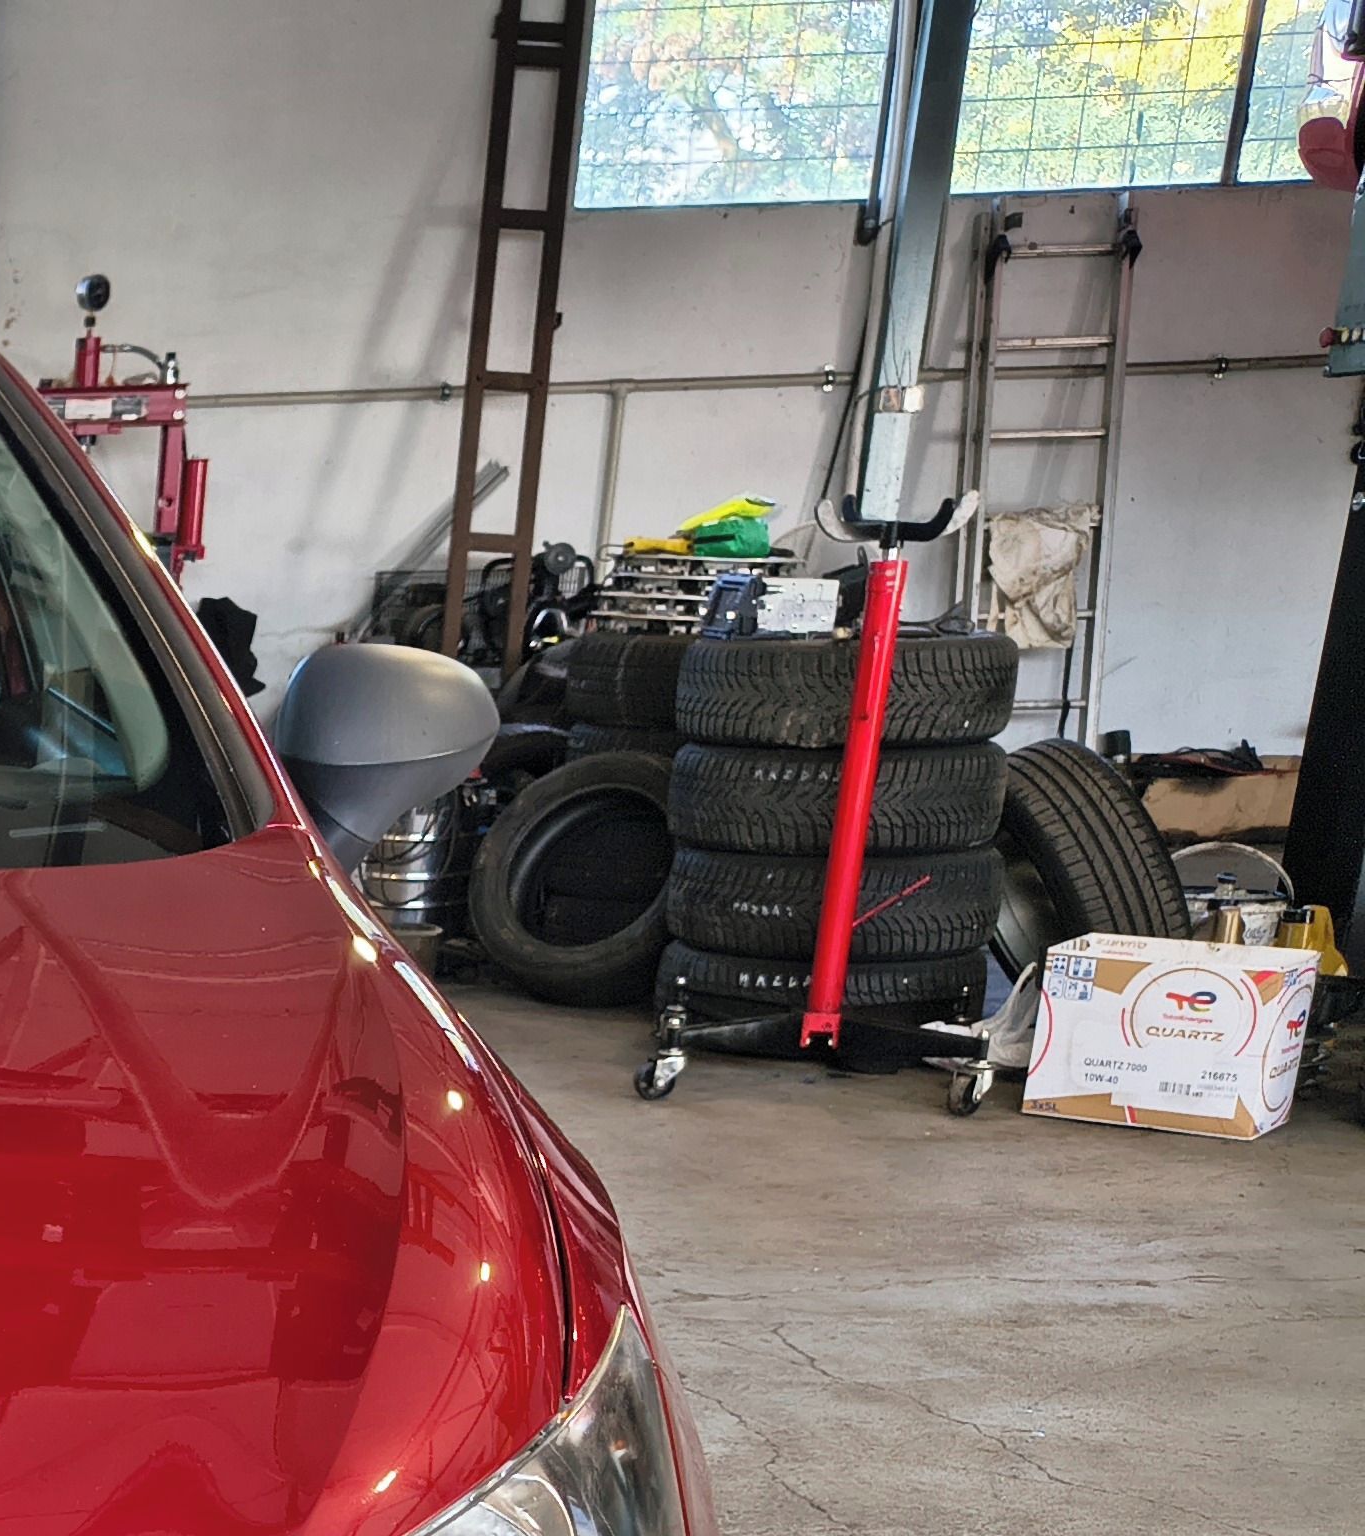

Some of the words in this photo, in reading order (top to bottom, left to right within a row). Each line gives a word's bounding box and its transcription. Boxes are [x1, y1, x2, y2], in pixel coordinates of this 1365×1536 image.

[1145, 1026, 1225, 1042] QUARTZ
[1083, 1057, 1124, 1070] QUARTZ
[1083, 1072, 1119, 1085] 10W-40
